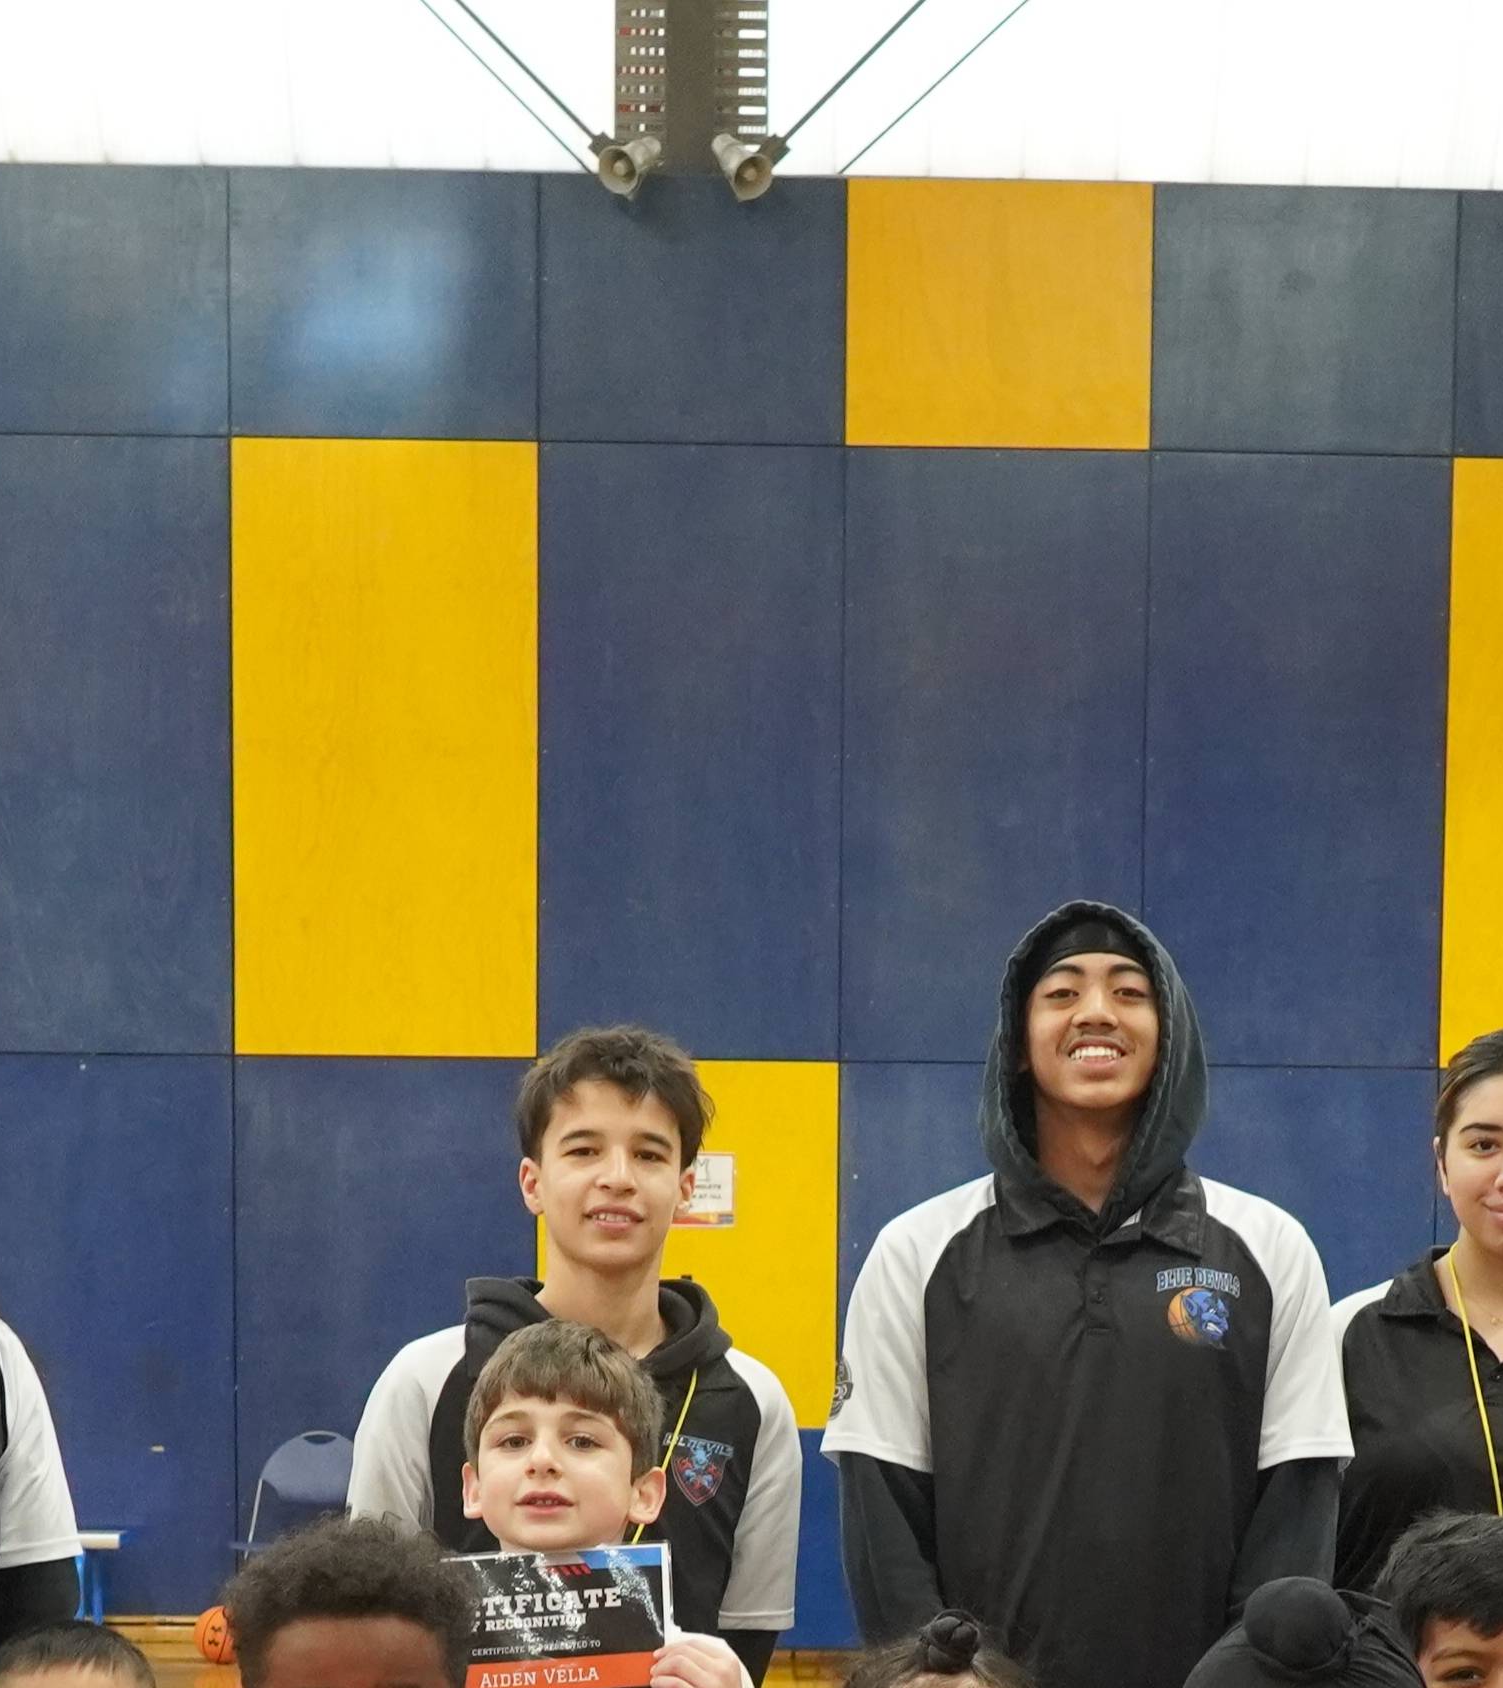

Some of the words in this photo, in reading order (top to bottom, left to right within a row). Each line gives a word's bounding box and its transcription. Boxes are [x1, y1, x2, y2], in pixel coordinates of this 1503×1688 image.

[1156, 1267, 1193, 1292] BLUE
[1195, 1267, 1241, 1298] DEVILS
[481, 1588, 620, 1616] TIFICATE
[485, 1613, 588, 1631] RECOGNITION
[479, 1668, 538, 1688] AIDEN
[542, 1664, 599, 1684] VELLA
